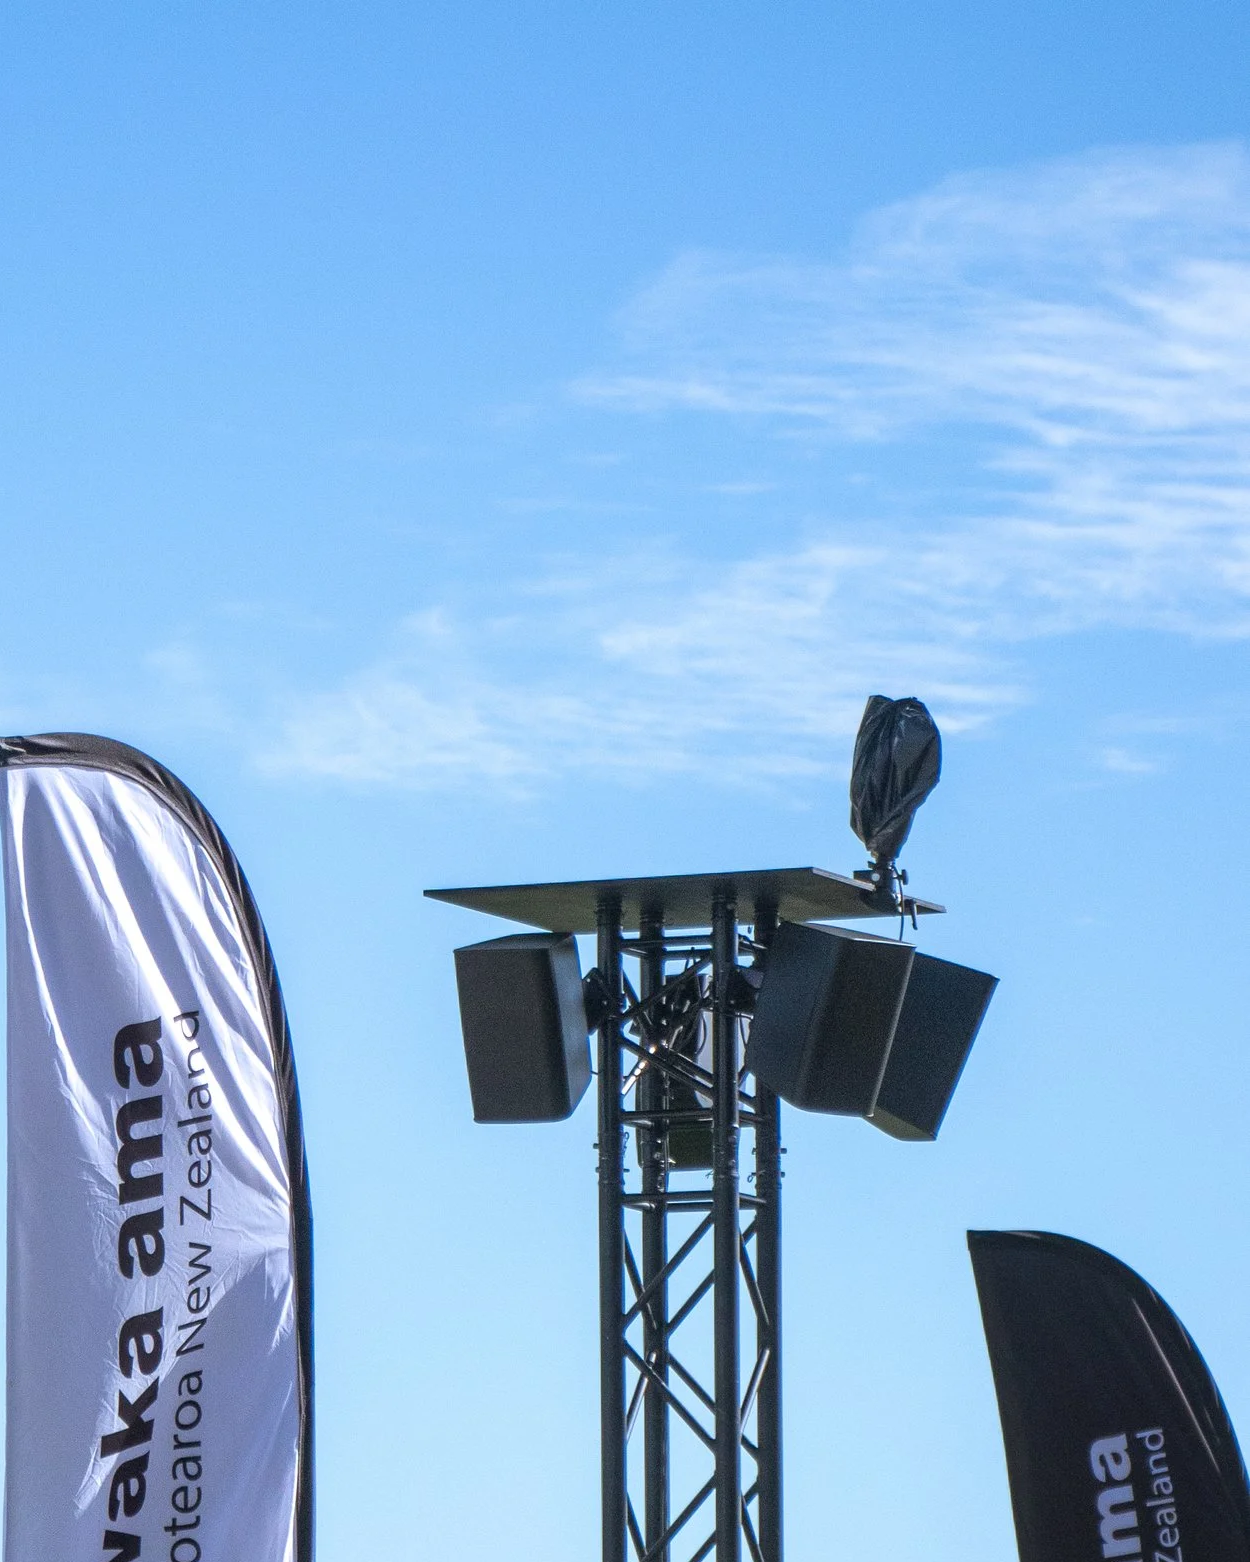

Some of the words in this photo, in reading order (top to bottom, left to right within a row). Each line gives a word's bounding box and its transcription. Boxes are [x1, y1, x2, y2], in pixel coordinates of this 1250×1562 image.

[114, 1016, 165, 1279] ama
[173, 1010, 213, 1226] Zealand
[176, 1242, 213, 1357] New
